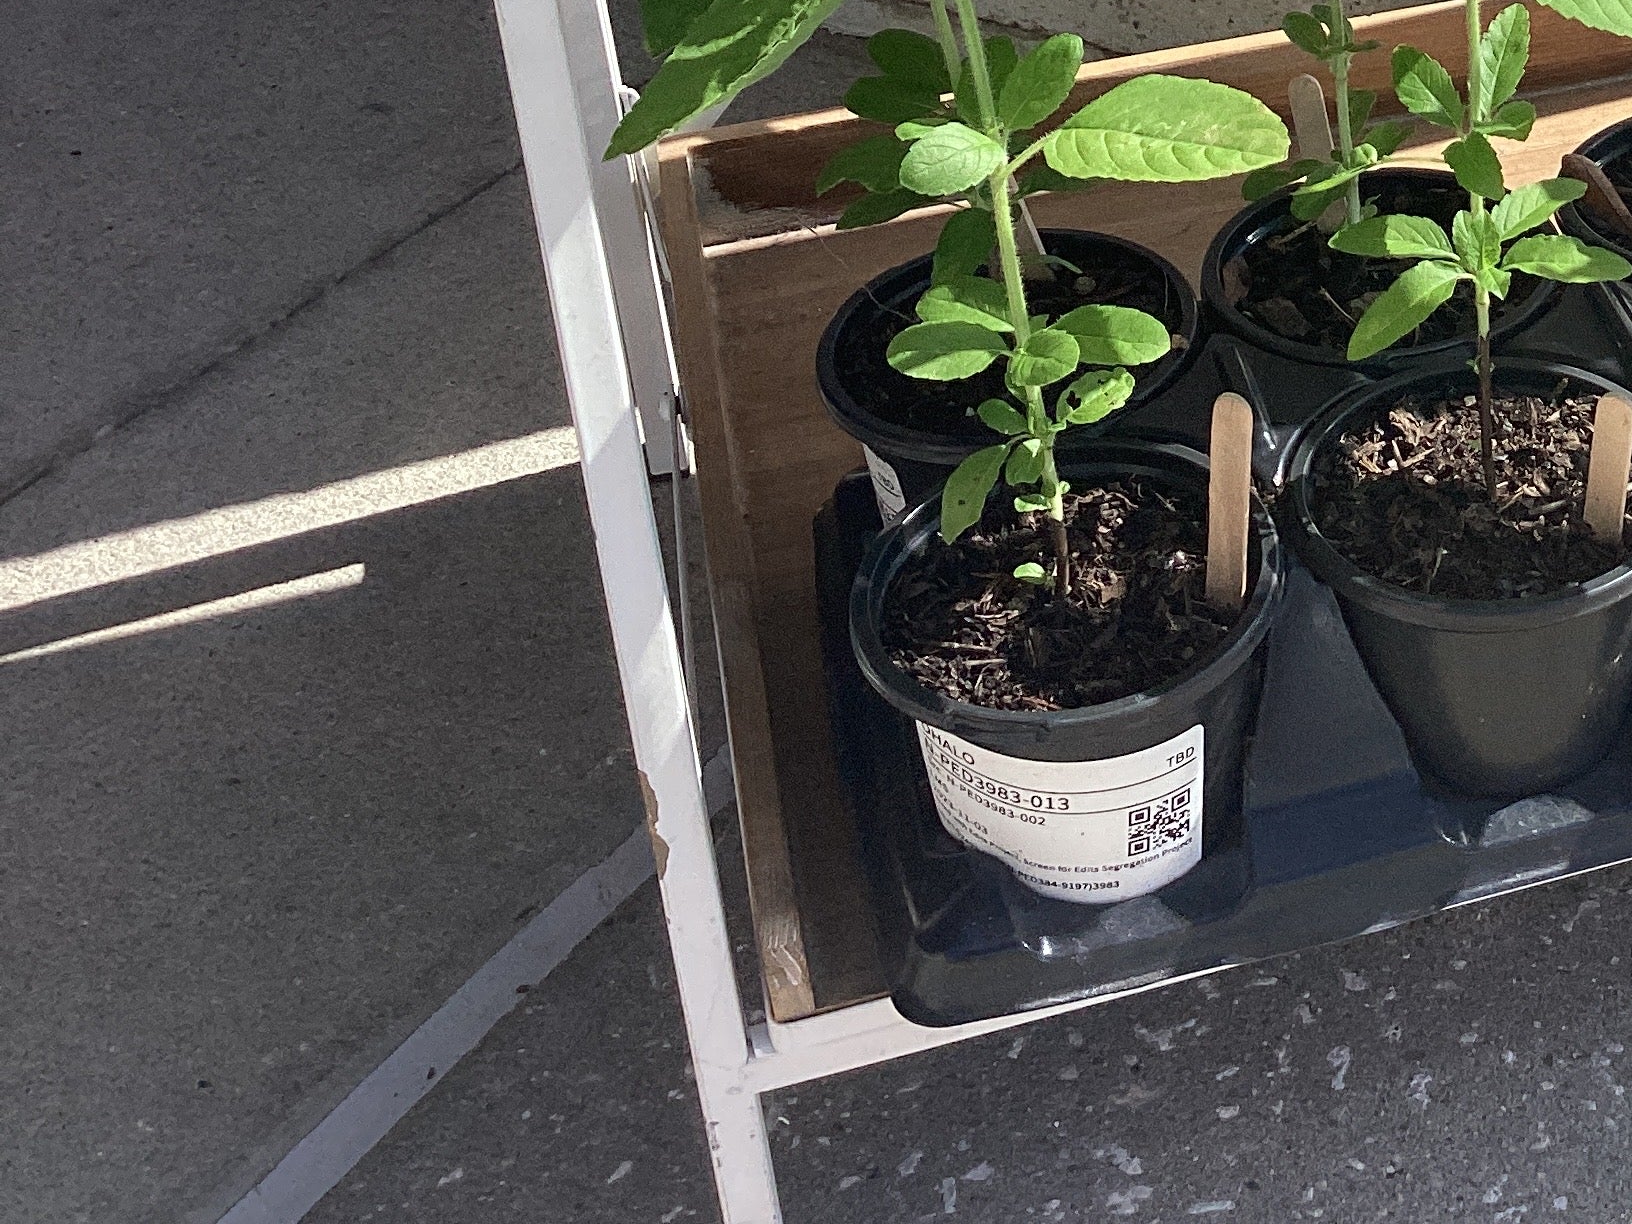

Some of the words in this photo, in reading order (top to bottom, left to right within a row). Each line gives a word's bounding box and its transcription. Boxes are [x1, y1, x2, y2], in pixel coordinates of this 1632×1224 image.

[1166, 745, 1195, 768] TBD
[1102, 853, 1160, 871] Segregation
[1162, 836, 1194, 857] Project
